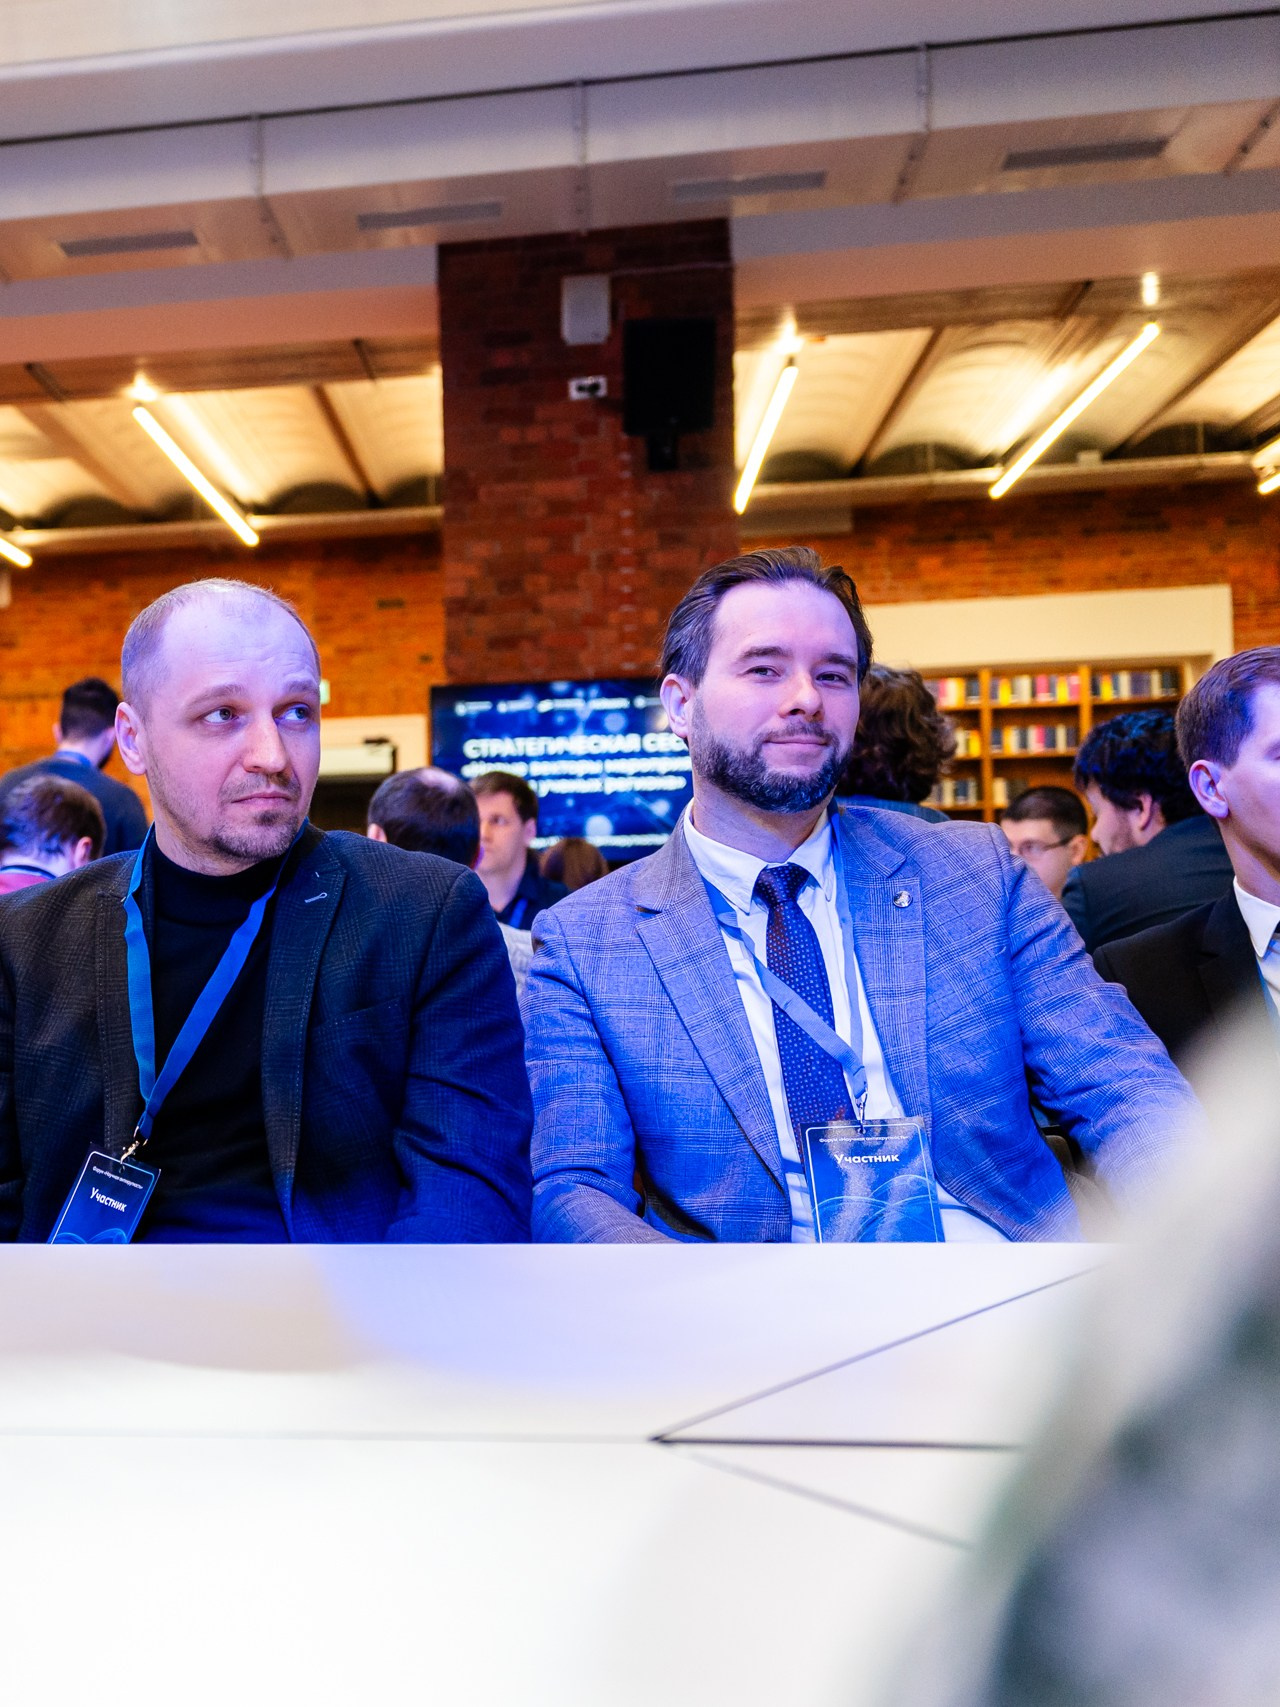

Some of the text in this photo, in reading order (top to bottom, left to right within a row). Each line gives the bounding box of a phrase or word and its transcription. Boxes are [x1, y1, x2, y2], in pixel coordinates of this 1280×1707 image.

[463, 732, 689, 759] СТРАТЕГИЧЕСКАЯ СЕС
[834, 1153, 900, 1164] Участник
[90, 1186, 128, 1213] Участник
